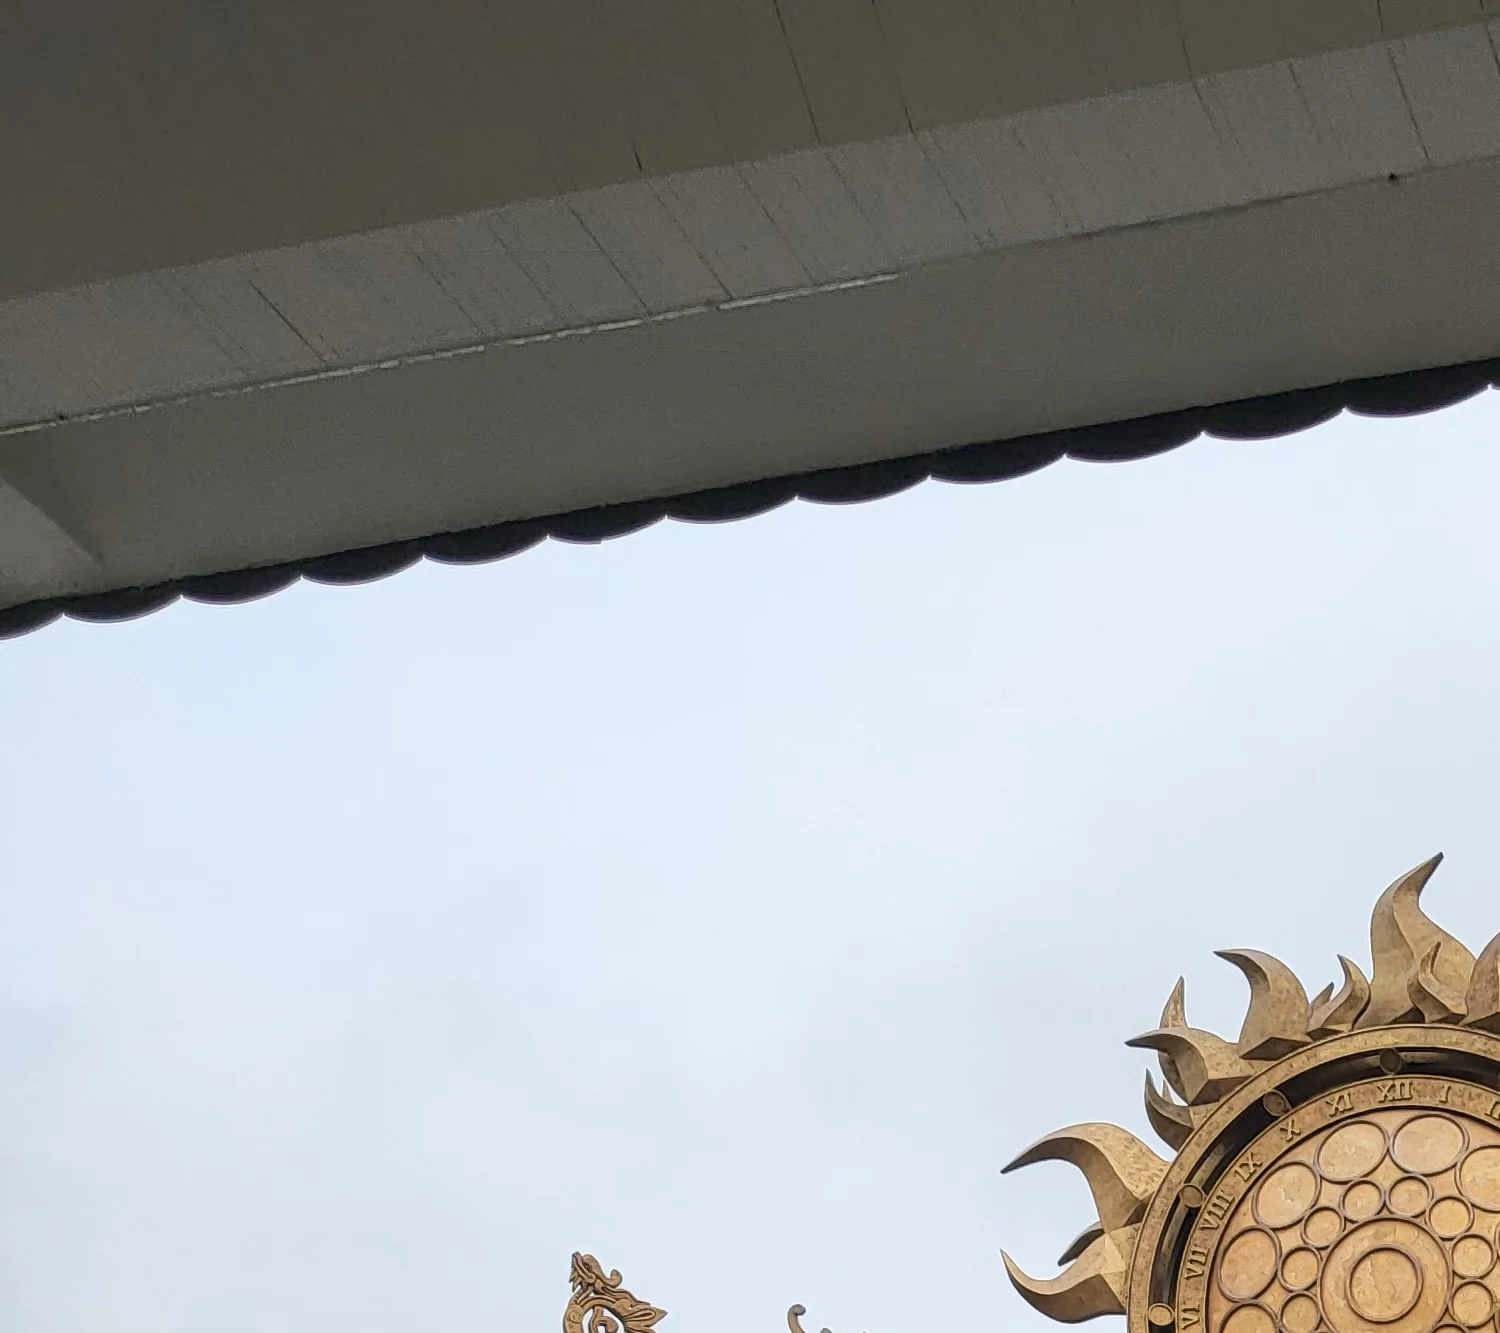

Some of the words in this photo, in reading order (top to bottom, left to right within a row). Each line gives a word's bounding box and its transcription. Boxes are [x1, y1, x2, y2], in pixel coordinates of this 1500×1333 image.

[1326, 1091, 1354, 1117] XI
[1376, 1080, 1413, 1103] XII
[1439, 1084, 1451, 1103] I
[1280, 1118, 1301, 1142] X
[1234, 1152, 1263, 1183] IX
[1199, 1189, 1235, 1233] VIII
[1185, 1246, 1210, 1281] VII
[1182, 1302, 1200, 1330] VI
